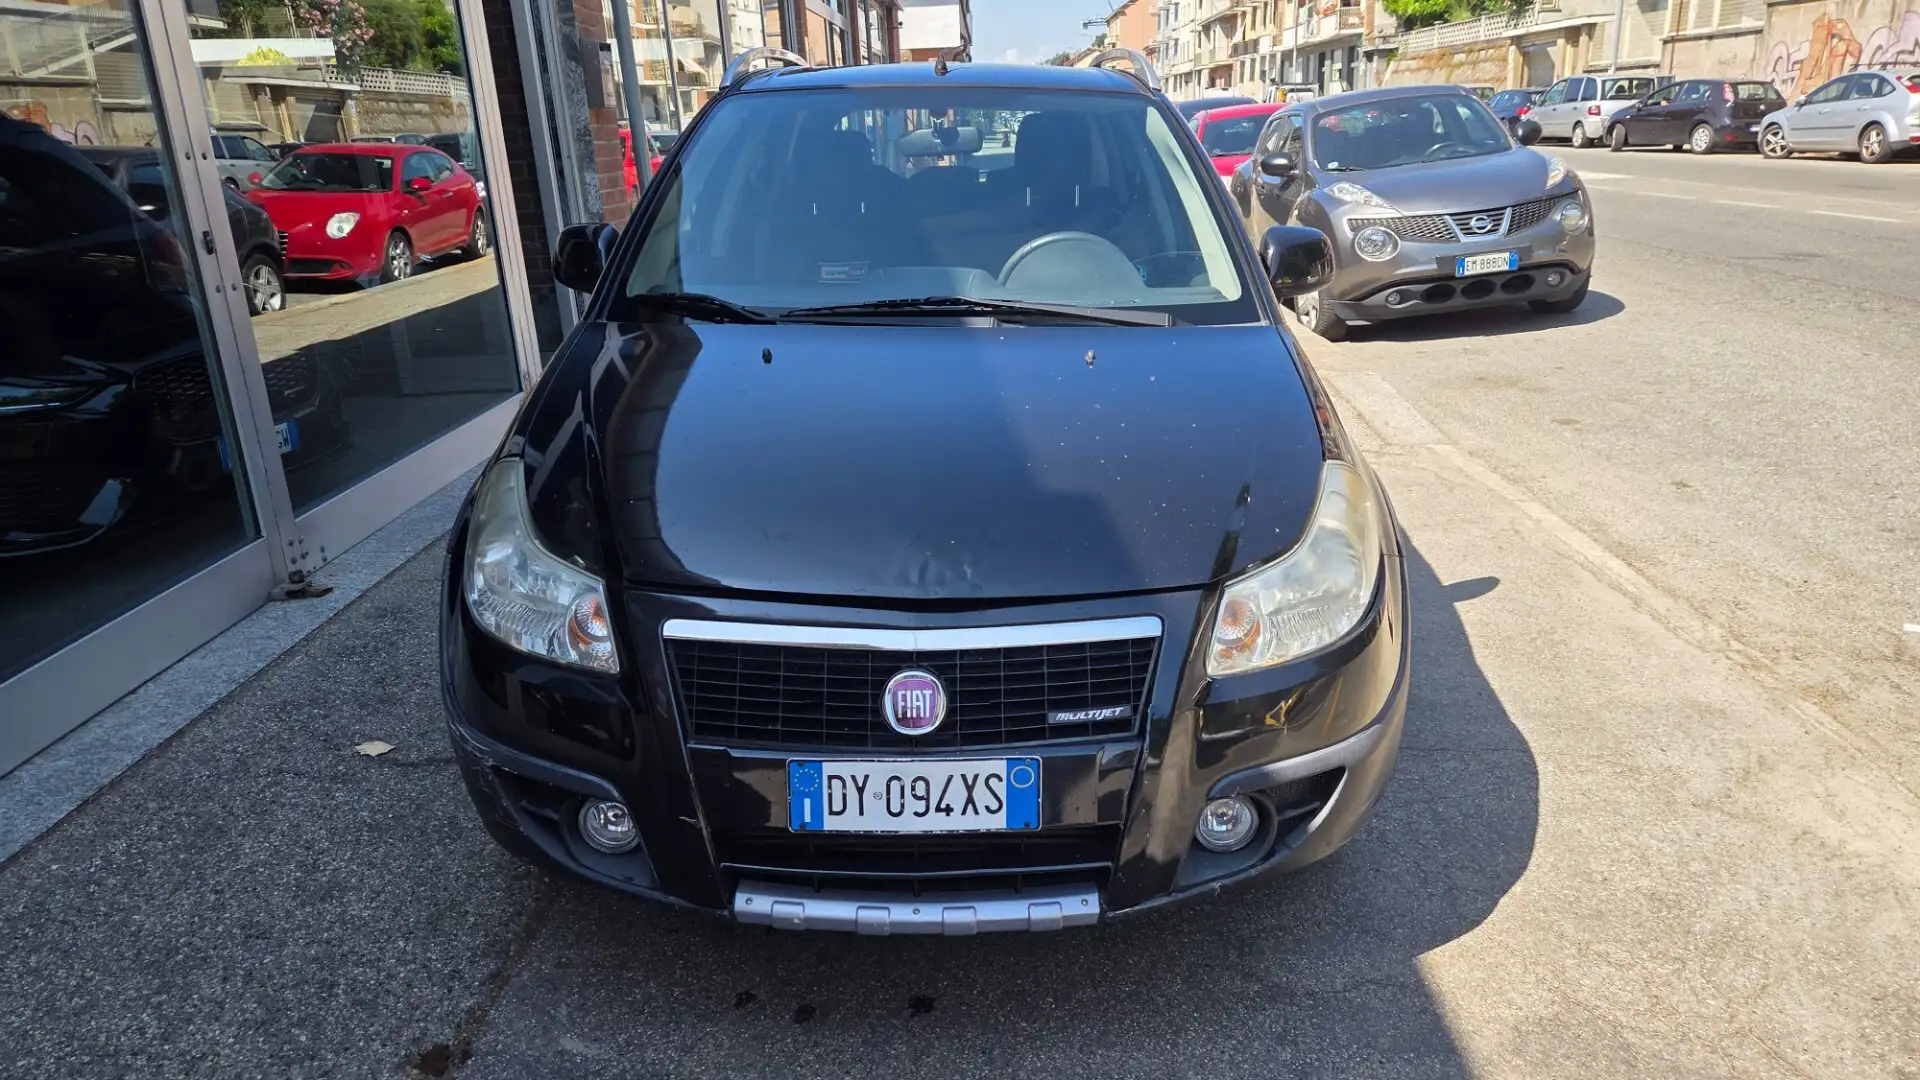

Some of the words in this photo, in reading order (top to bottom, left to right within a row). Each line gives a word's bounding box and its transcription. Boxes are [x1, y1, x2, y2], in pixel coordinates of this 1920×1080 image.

[897, 689, 933, 719] FIAT
[1055, 706, 1124, 721] MULTIJET
[826, 773, 871, 817] DY
[885, 772, 1004, 818] 094XS
